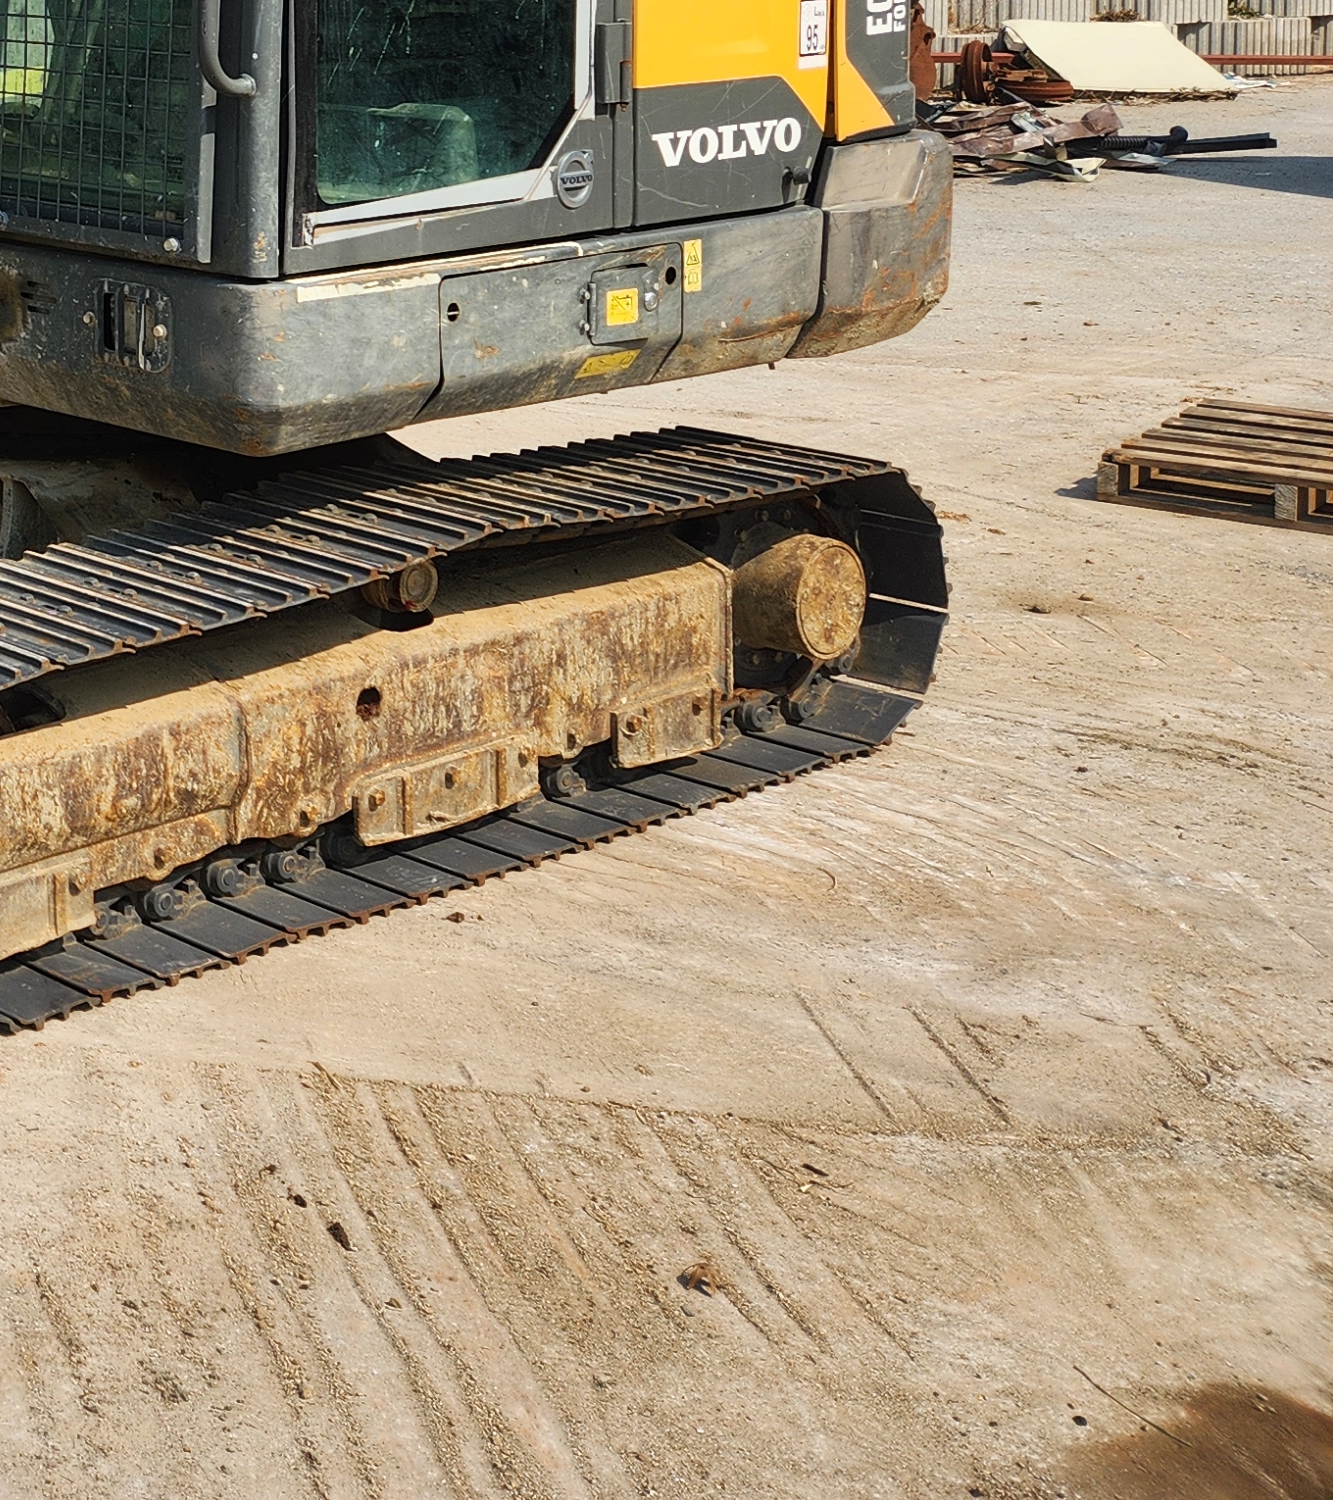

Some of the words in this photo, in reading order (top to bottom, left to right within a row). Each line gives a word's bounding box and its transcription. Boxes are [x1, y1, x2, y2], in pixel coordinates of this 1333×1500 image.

[806, 24, 819, 52] 95
[651, 117, 802, 168] VOLVO
[559, 173, 593, 186] VOLVO
